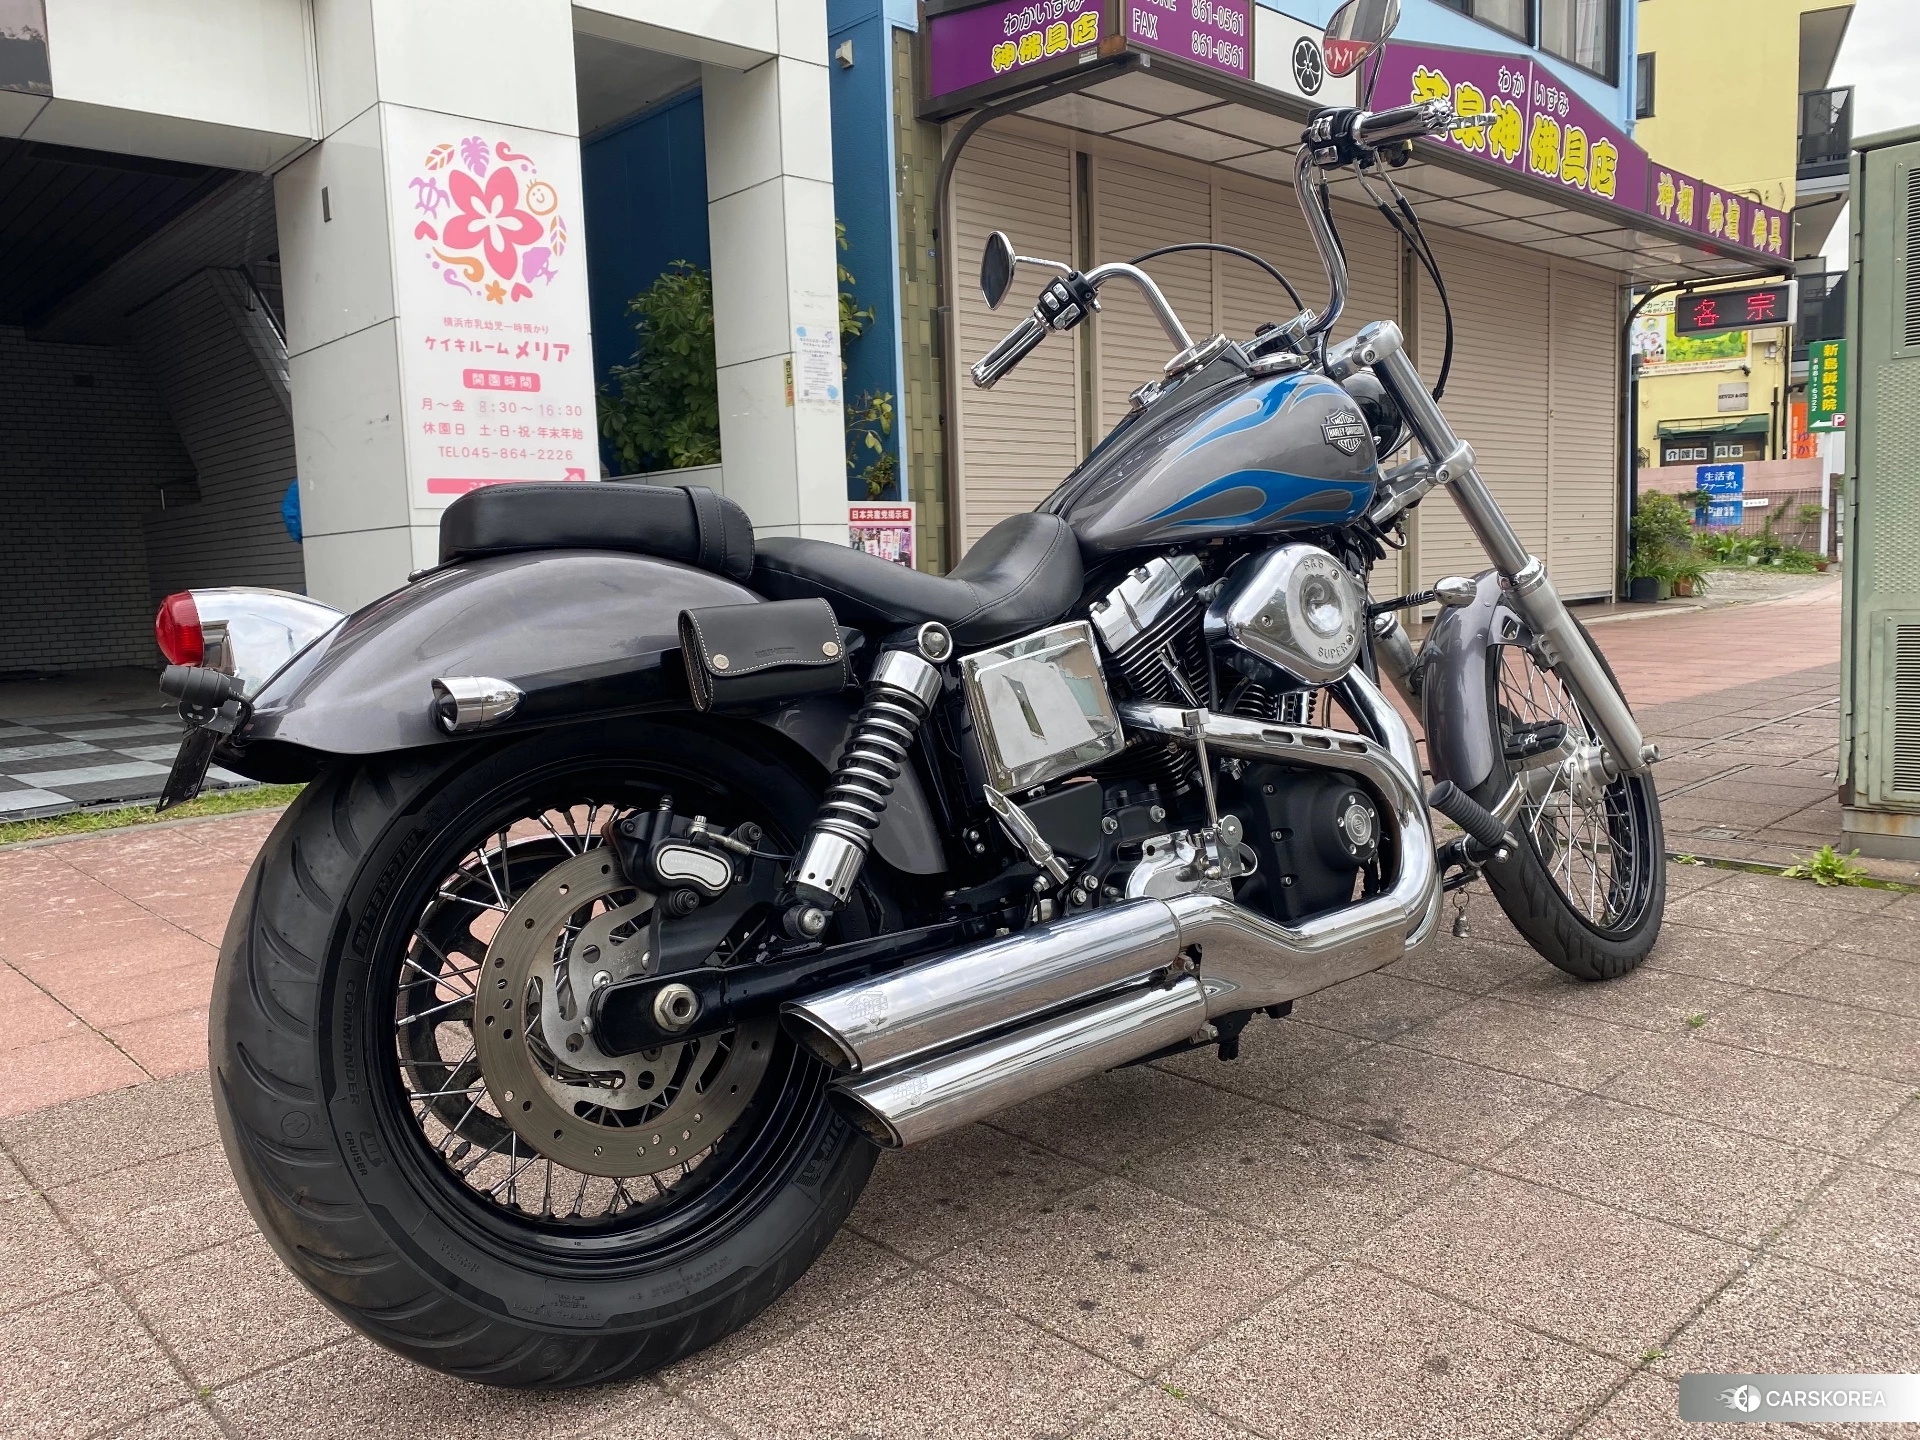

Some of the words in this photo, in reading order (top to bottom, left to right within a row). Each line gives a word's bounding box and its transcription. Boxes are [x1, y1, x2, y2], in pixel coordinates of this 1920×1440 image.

[1192, 0, 1244, 37] 861-0561
[1132, 7, 1158, 40] FAX
[1192, 30, 1244, 70] 861-0561
[443, 316, 549, 335] 横浜市乳幼児一時預かり
[424, 336, 510, 355] ケイキルーム
[515, 341, 570, 363] メリア
[472, 373, 533, 389] 開園時間
[422, 421, 466, 436] 休園日
[1834, 414, 1846, 427] P
[1704, 471, 1736, 482] 生活者
[1701, 481, 1739, 490] ファースト
[852, 509, 910, 520] 日本共産党掲示板
[1303, 558, 1324, 571] S&S
[1317, 642, 1348, 659] SUPER
[354, 831, 420, 951] MICHELIN
[342, 979, 361, 1107] COMMANDER
[344, 1130, 368, 1178] CRUISER
